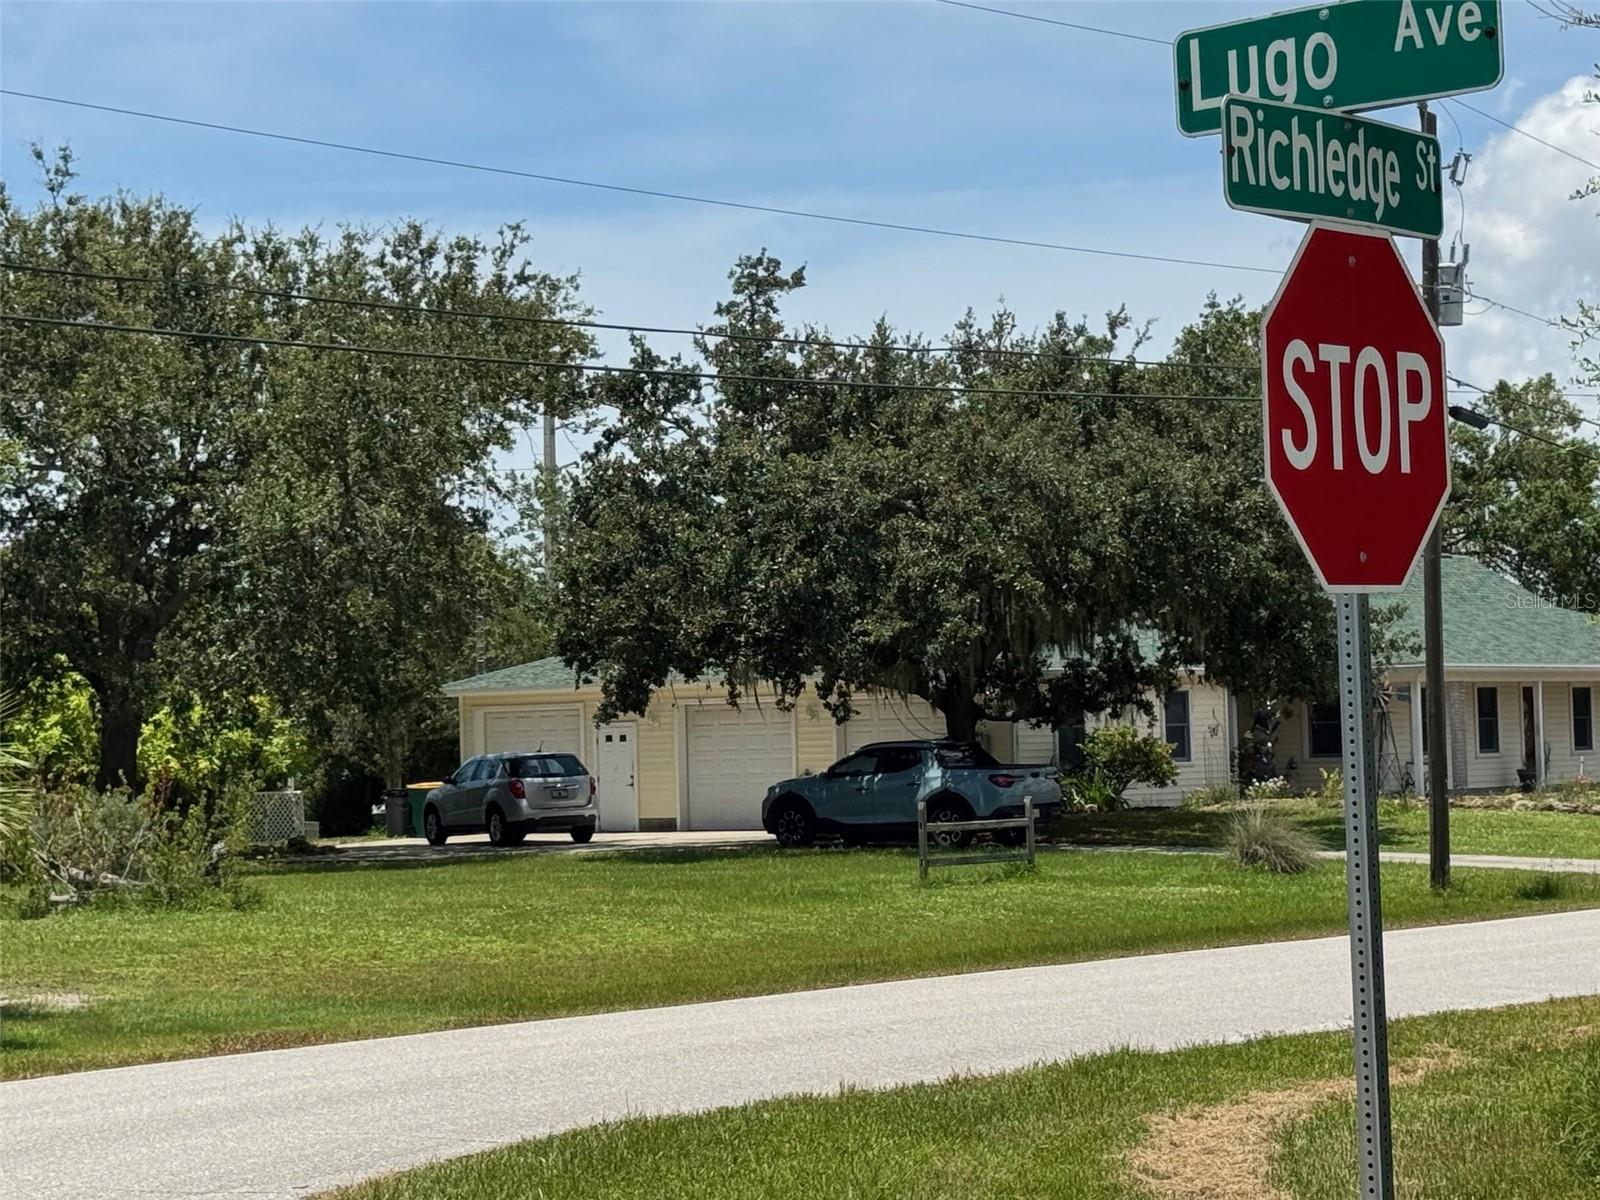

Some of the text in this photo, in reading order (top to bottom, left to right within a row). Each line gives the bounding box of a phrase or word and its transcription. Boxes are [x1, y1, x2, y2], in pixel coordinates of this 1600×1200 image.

[1189, 0, 1482, 112] Lugo Ave
[1230, 104, 1437, 222] Richledge St
[1281, 338, 1432, 475] STOP
